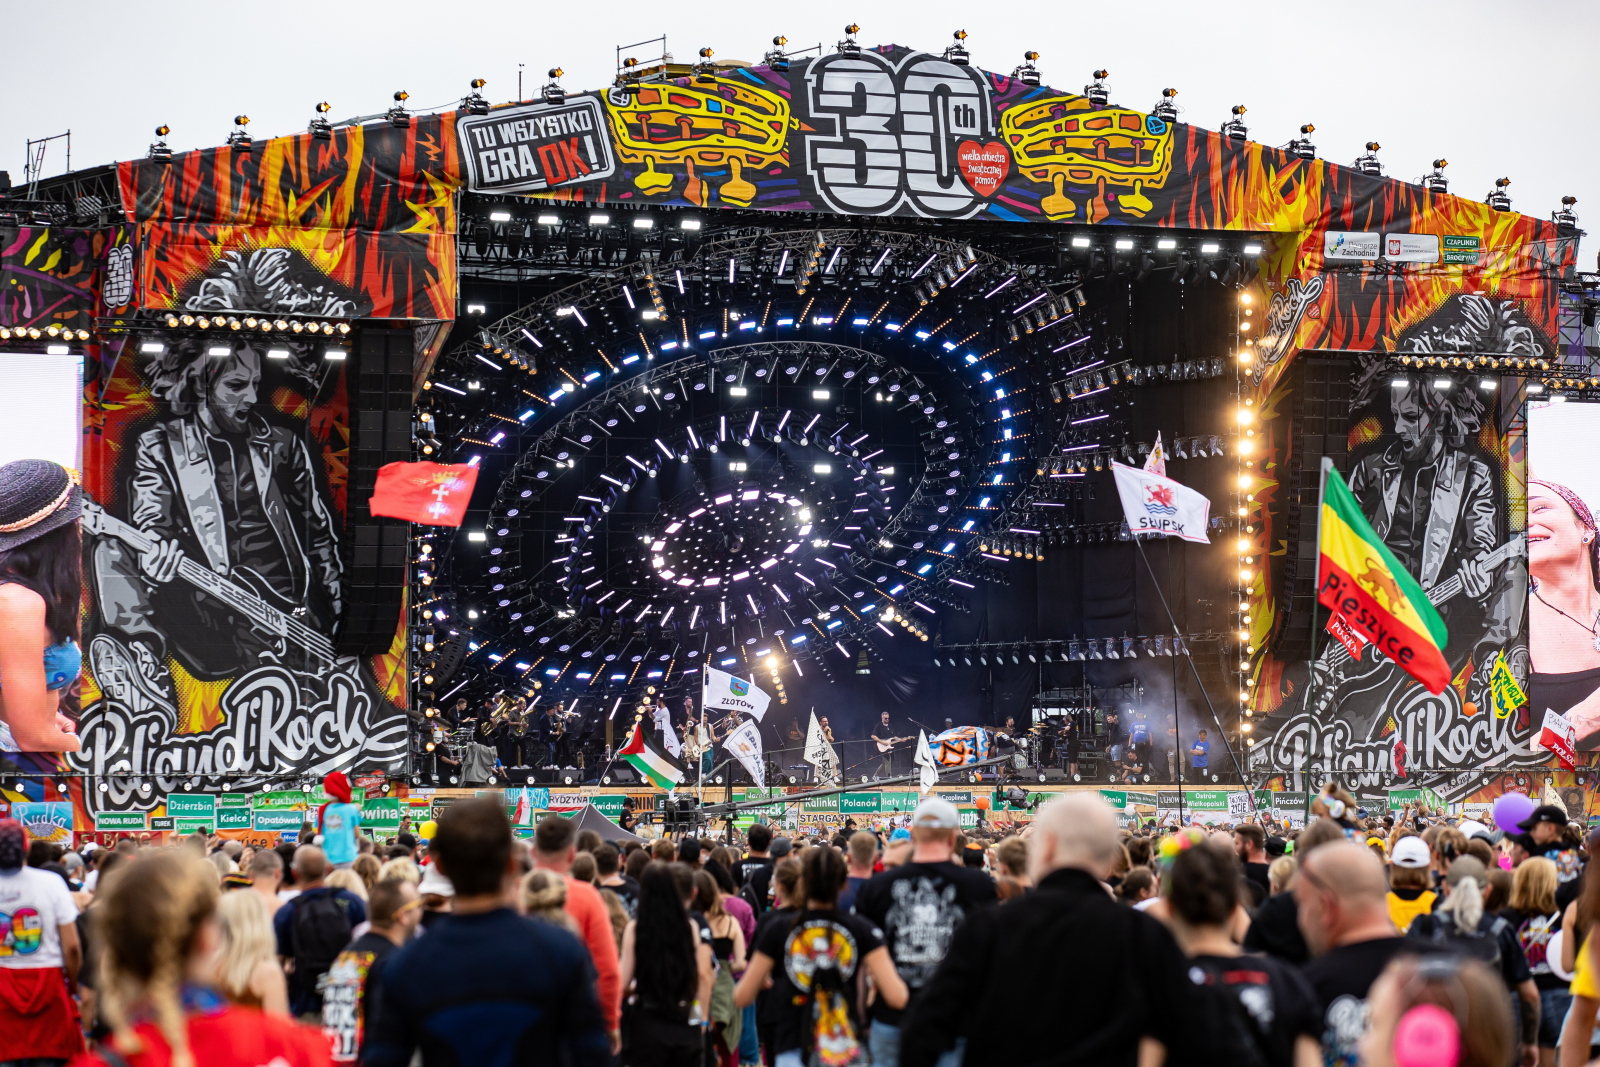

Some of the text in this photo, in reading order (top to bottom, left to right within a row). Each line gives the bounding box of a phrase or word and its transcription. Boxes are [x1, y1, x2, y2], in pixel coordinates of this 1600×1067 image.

[472, 109, 593, 149] TU WSZYSTKO
[961, 149, 1006, 163] wielka orkiestra
[478, 144, 538, 183] GRA
[967, 161, 1003, 179] świątecznej
[974, 176, 998, 189] pomocy
[1348, 241, 1378, 250] Pomorze
[1341, 248, 1376, 257] Zachodnie
[1139, 516, 1185, 535] SŁUPSK
[1320, 571, 1415, 665] Pieszyce
[720, 697, 755, 711] ZŁOTÓW
[1551, 741, 1575, 768] POLSK
[550, 795, 588, 804] RYDZYNA
[941, 794, 968, 802] Czaplinek
[1104, 795, 1122, 803] Konin
[1195, 791, 1217, 799] Ostrów
[1275, 796, 1305, 805] Pińczów
[169, 800, 212, 811] Dzierzbin
[805, 797, 838, 808] Kalinka
[843, 796, 877, 807] Polanów
[1187, 800, 1225, 808] Wielkopolski
[15, 802, 66, 828] Rudka
[220, 814, 248, 823] Kielce
[257, 815, 301, 825] Opatówek
[800, 814, 851, 823] STARGARD
[122, 817, 143, 825] RUDA
